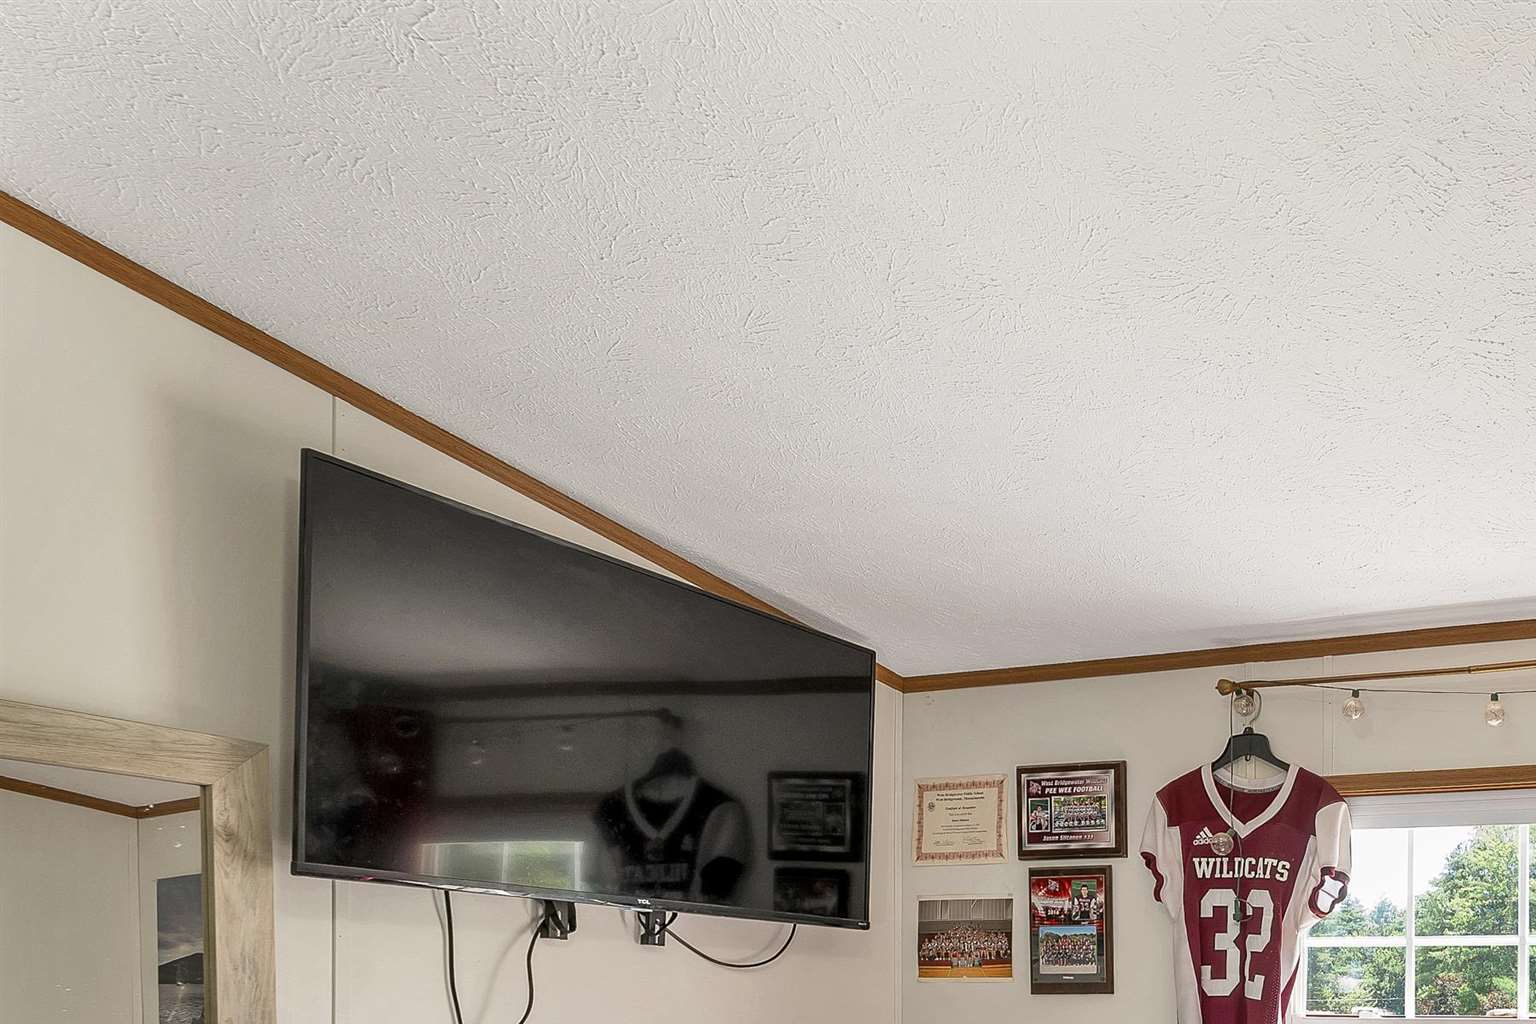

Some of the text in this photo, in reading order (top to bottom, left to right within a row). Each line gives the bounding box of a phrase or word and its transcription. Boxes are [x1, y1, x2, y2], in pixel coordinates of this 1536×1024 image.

[1058, 786, 1073, 794] WEE
[1073, 785, 1104, 793] FOOTBALL
[1192, 857, 1291, 882] WILDCATS
[1200, 888, 1274, 1000] 32
